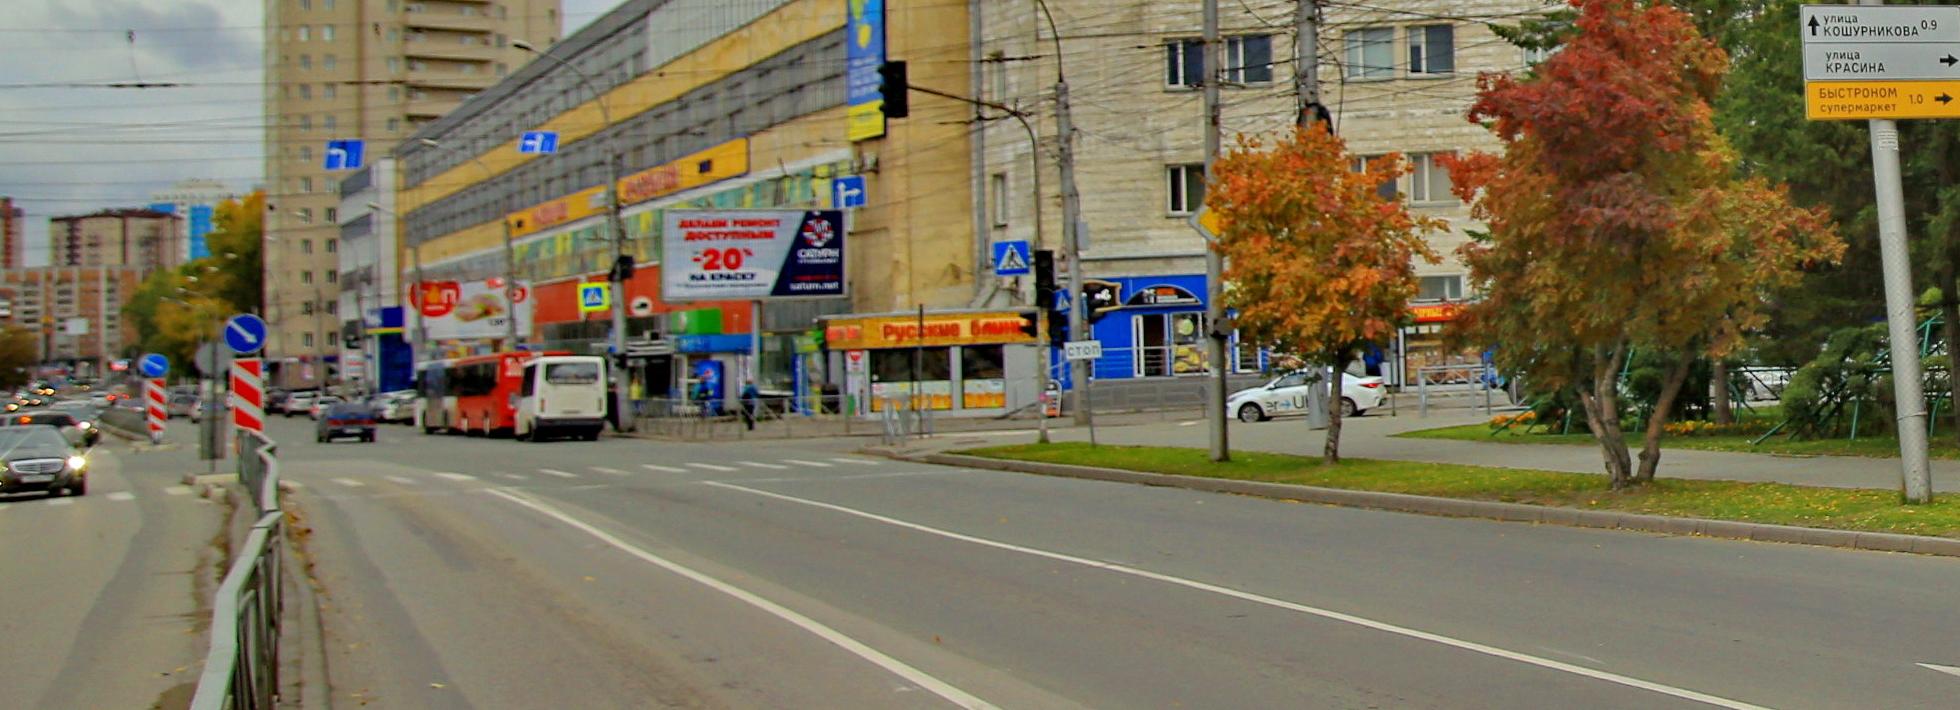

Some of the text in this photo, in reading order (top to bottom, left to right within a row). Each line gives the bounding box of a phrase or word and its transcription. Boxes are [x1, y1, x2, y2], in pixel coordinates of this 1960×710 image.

[1824, 15, 1858, 24] улица
[1921, 20, 1937, 31] 0.9
[1824, 26, 1919, 37] КОШУРНИКОВА
[1826, 51, 1860, 61] улица
[1826, 62, 1885, 73] КРАСИНА
[1820, 88, 1897, 99] БЫСТРОНОМ
[1909, 94, 1924, 105] 1.0
[1820, 102, 1896, 113] супермаркет
